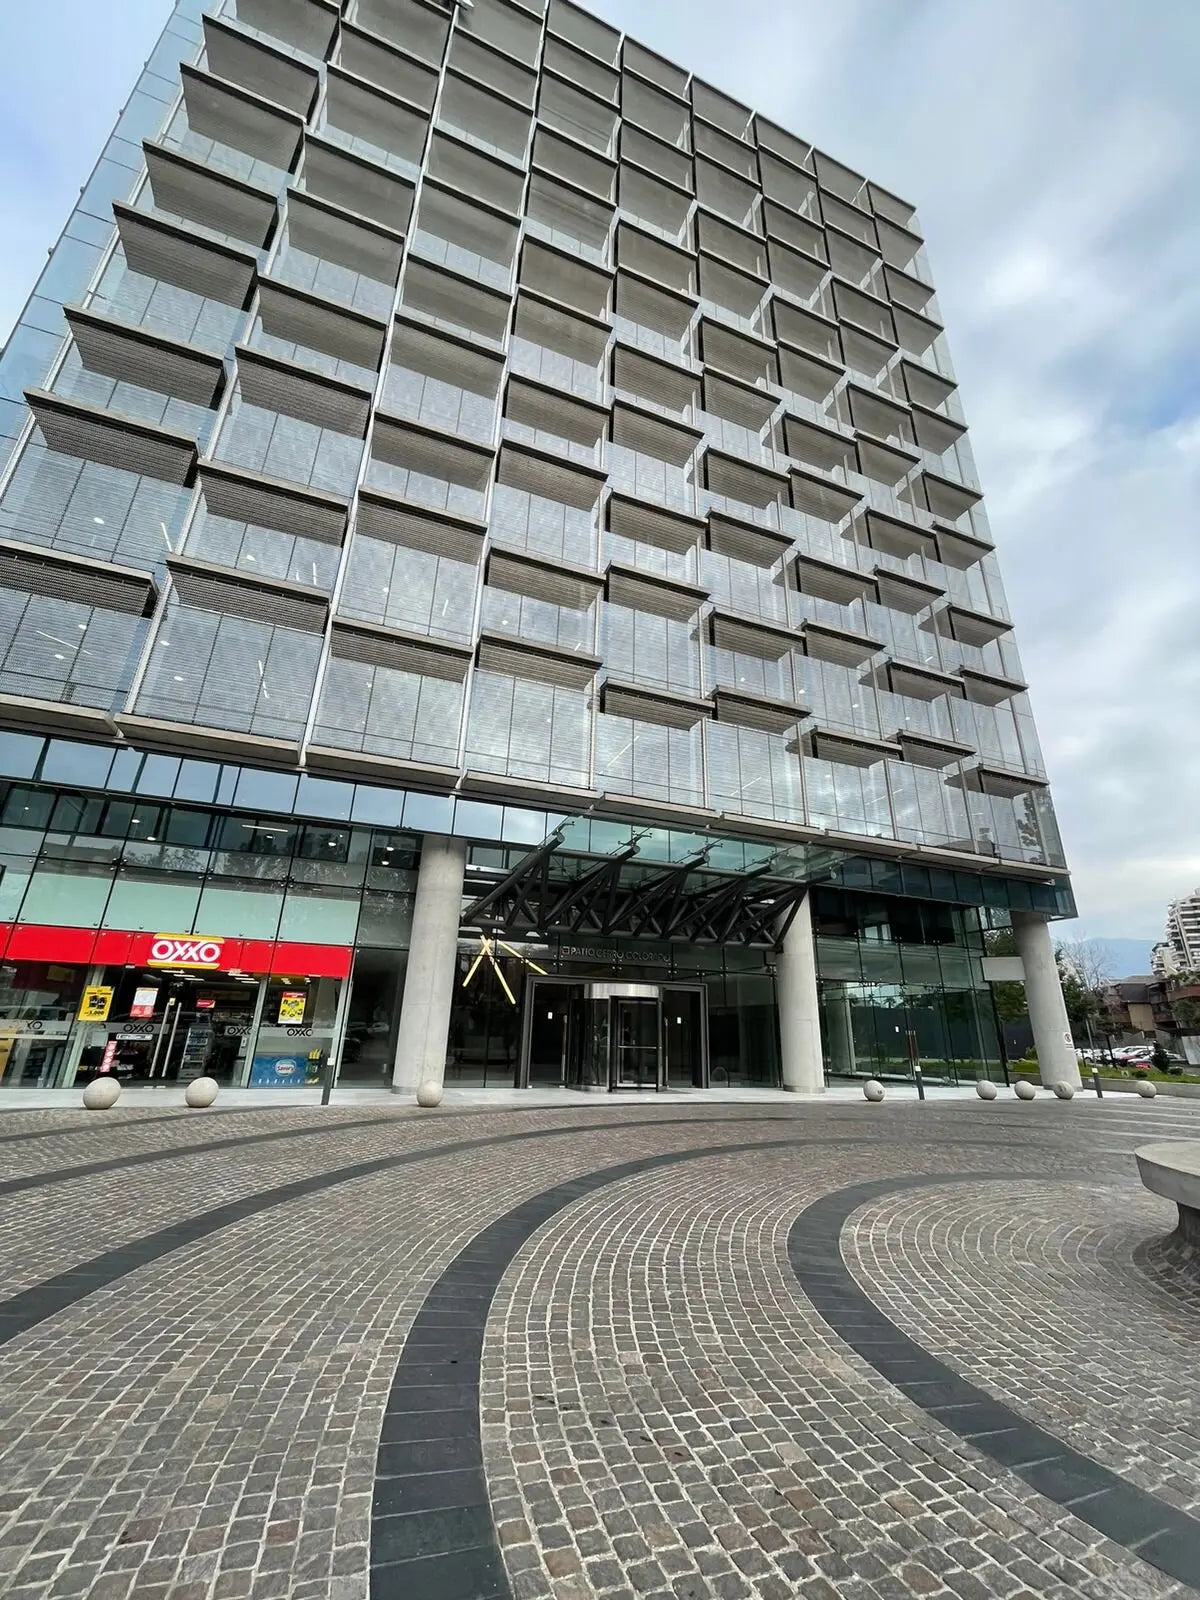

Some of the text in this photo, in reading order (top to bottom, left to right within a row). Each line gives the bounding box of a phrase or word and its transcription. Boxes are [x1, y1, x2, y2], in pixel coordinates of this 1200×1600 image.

[152, 940, 220, 962] OXXO
[123, 1022, 154, 1034] OXXO
[287, 1027, 313, 1037] OXXO
